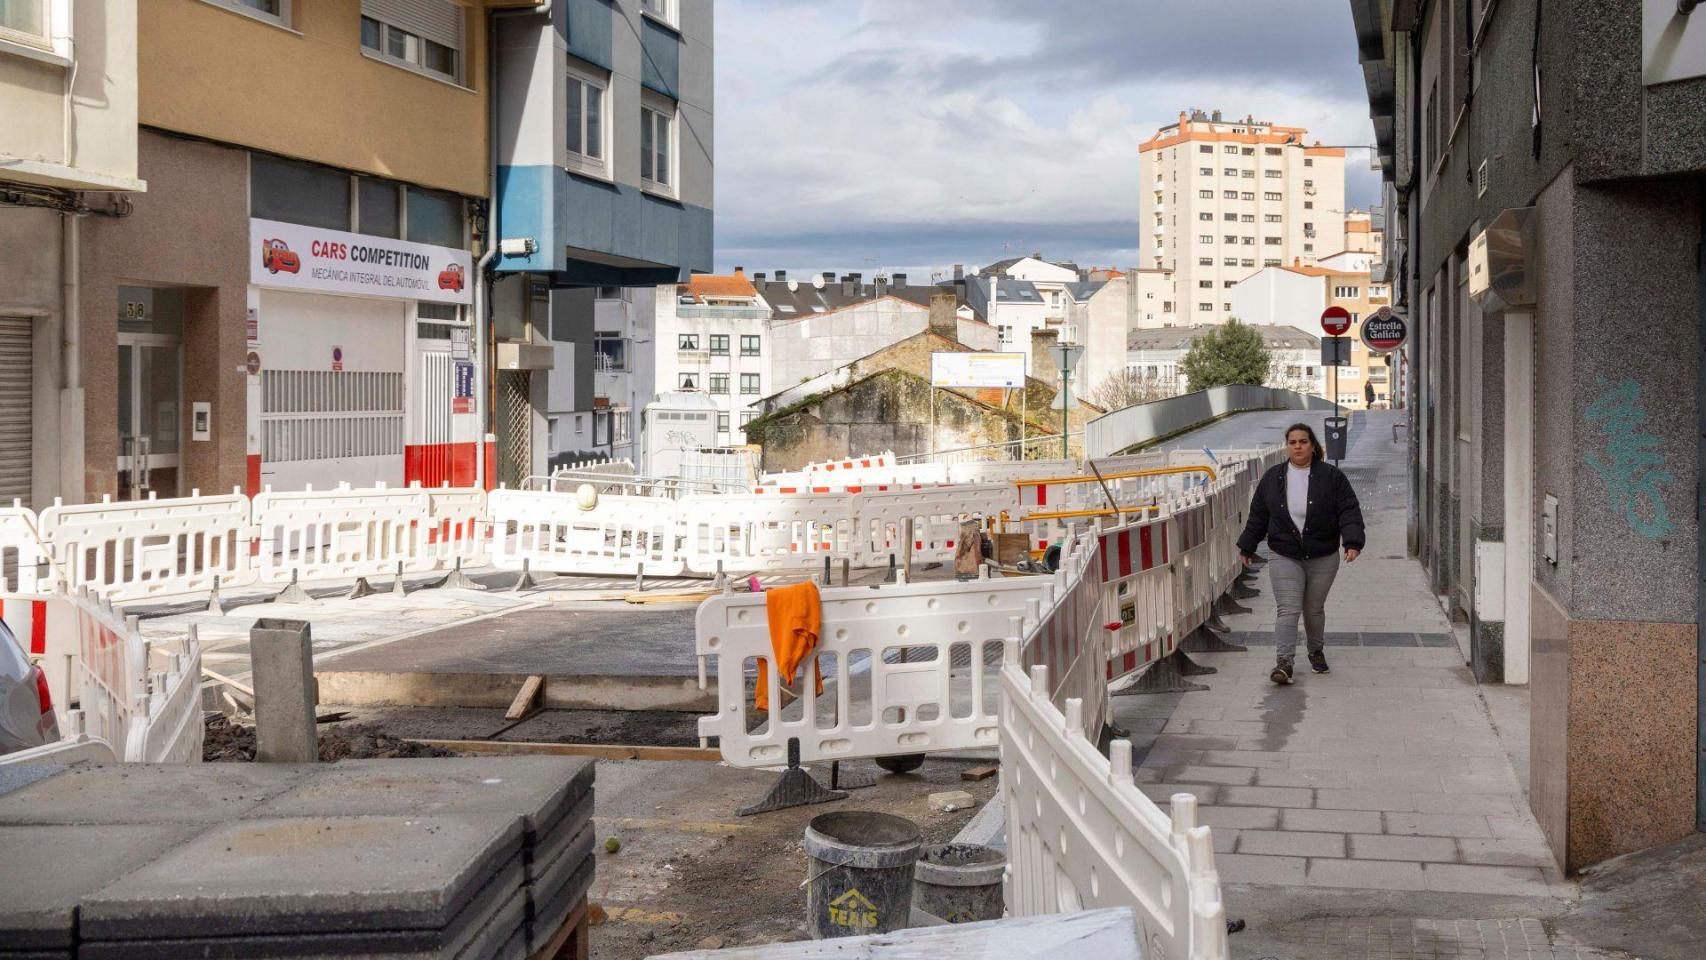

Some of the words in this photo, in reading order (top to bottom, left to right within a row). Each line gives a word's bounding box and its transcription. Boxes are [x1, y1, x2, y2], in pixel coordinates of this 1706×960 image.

[311, 240, 347, 260] CARS
[350, 245, 430, 271] COMPETITION
[349, 271, 381, 286] INTEGRAL
[127, 302, 144, 317] 38
[1368, 321, 1402, 331] Estrella
[1369, 330, 1400, 339] Galicia
